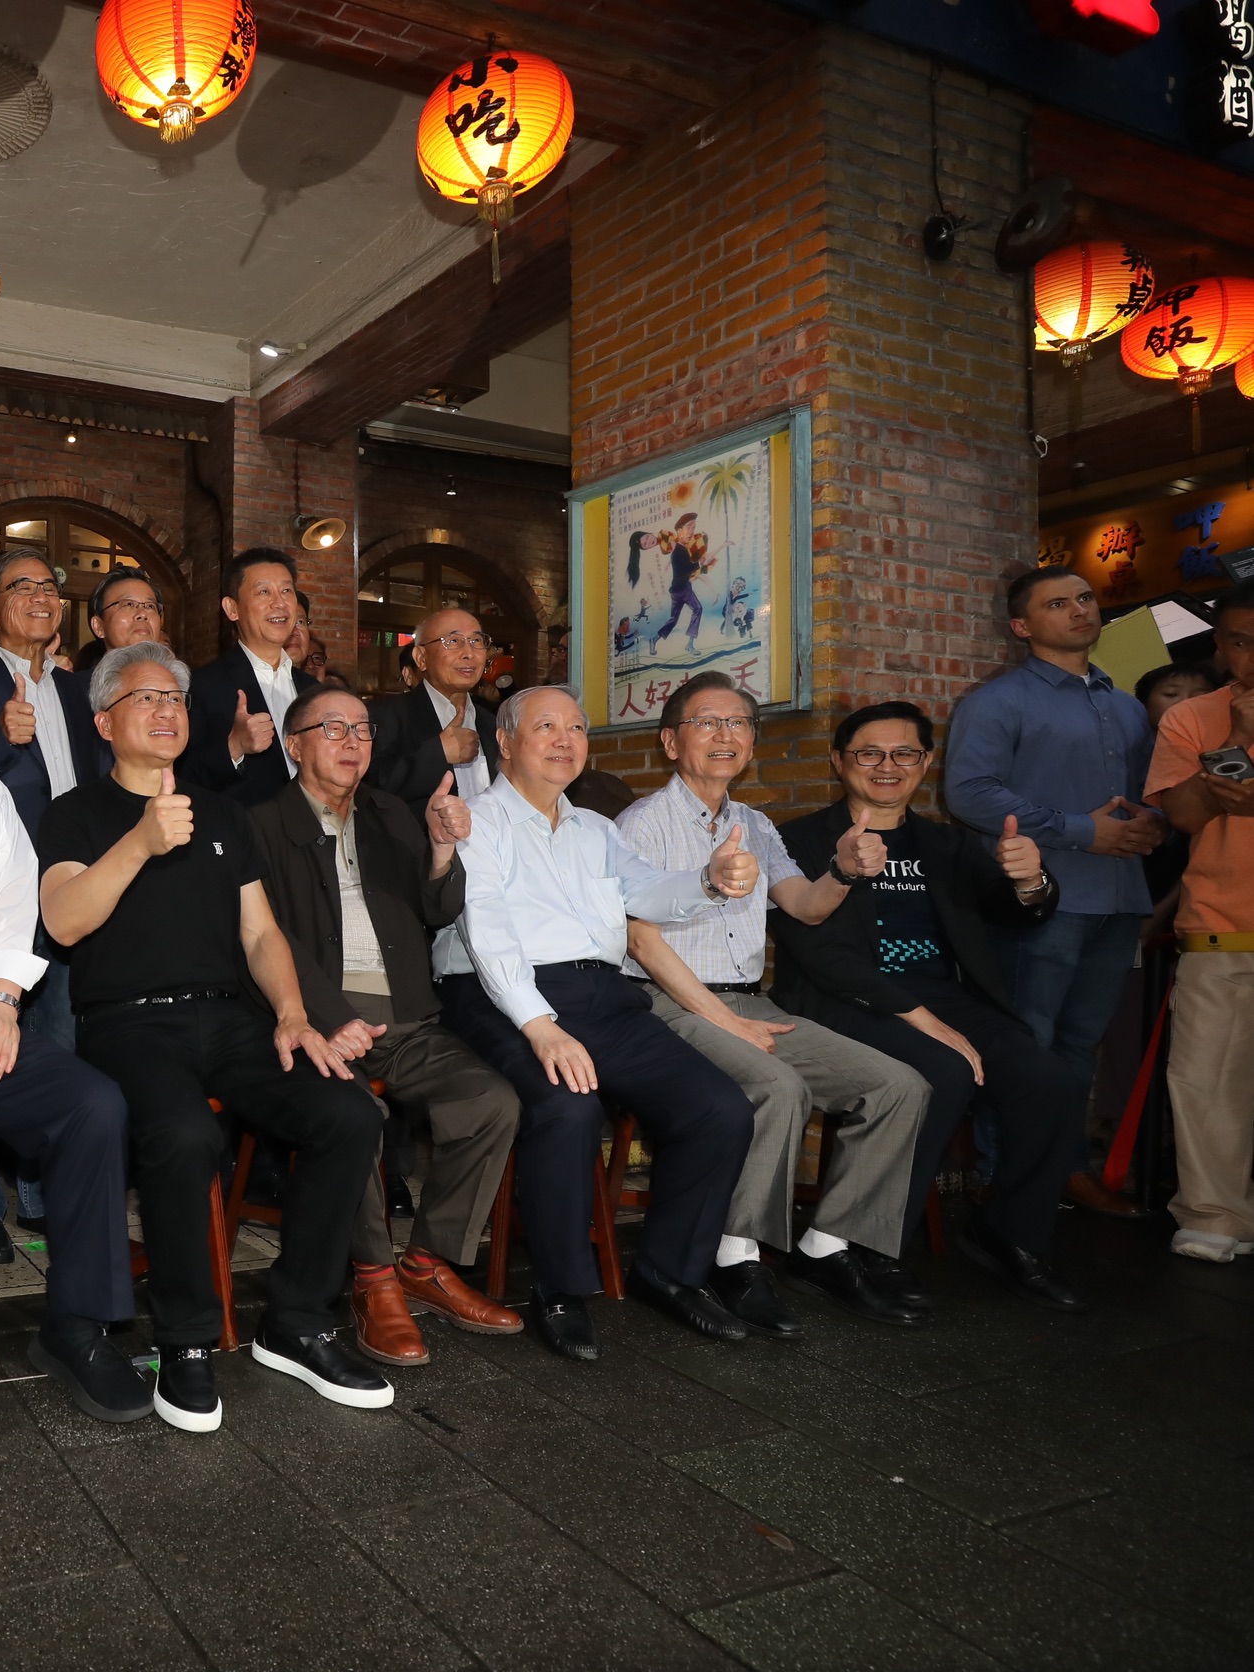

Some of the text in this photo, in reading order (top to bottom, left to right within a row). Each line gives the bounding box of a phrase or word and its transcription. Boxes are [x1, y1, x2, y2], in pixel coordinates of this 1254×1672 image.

[446, 55, 520, 146] 小吃
[1143, 284, 1208, 358] 呷飯
[879, 881, 895, 891] the
[896, 882, 927, 892] future
